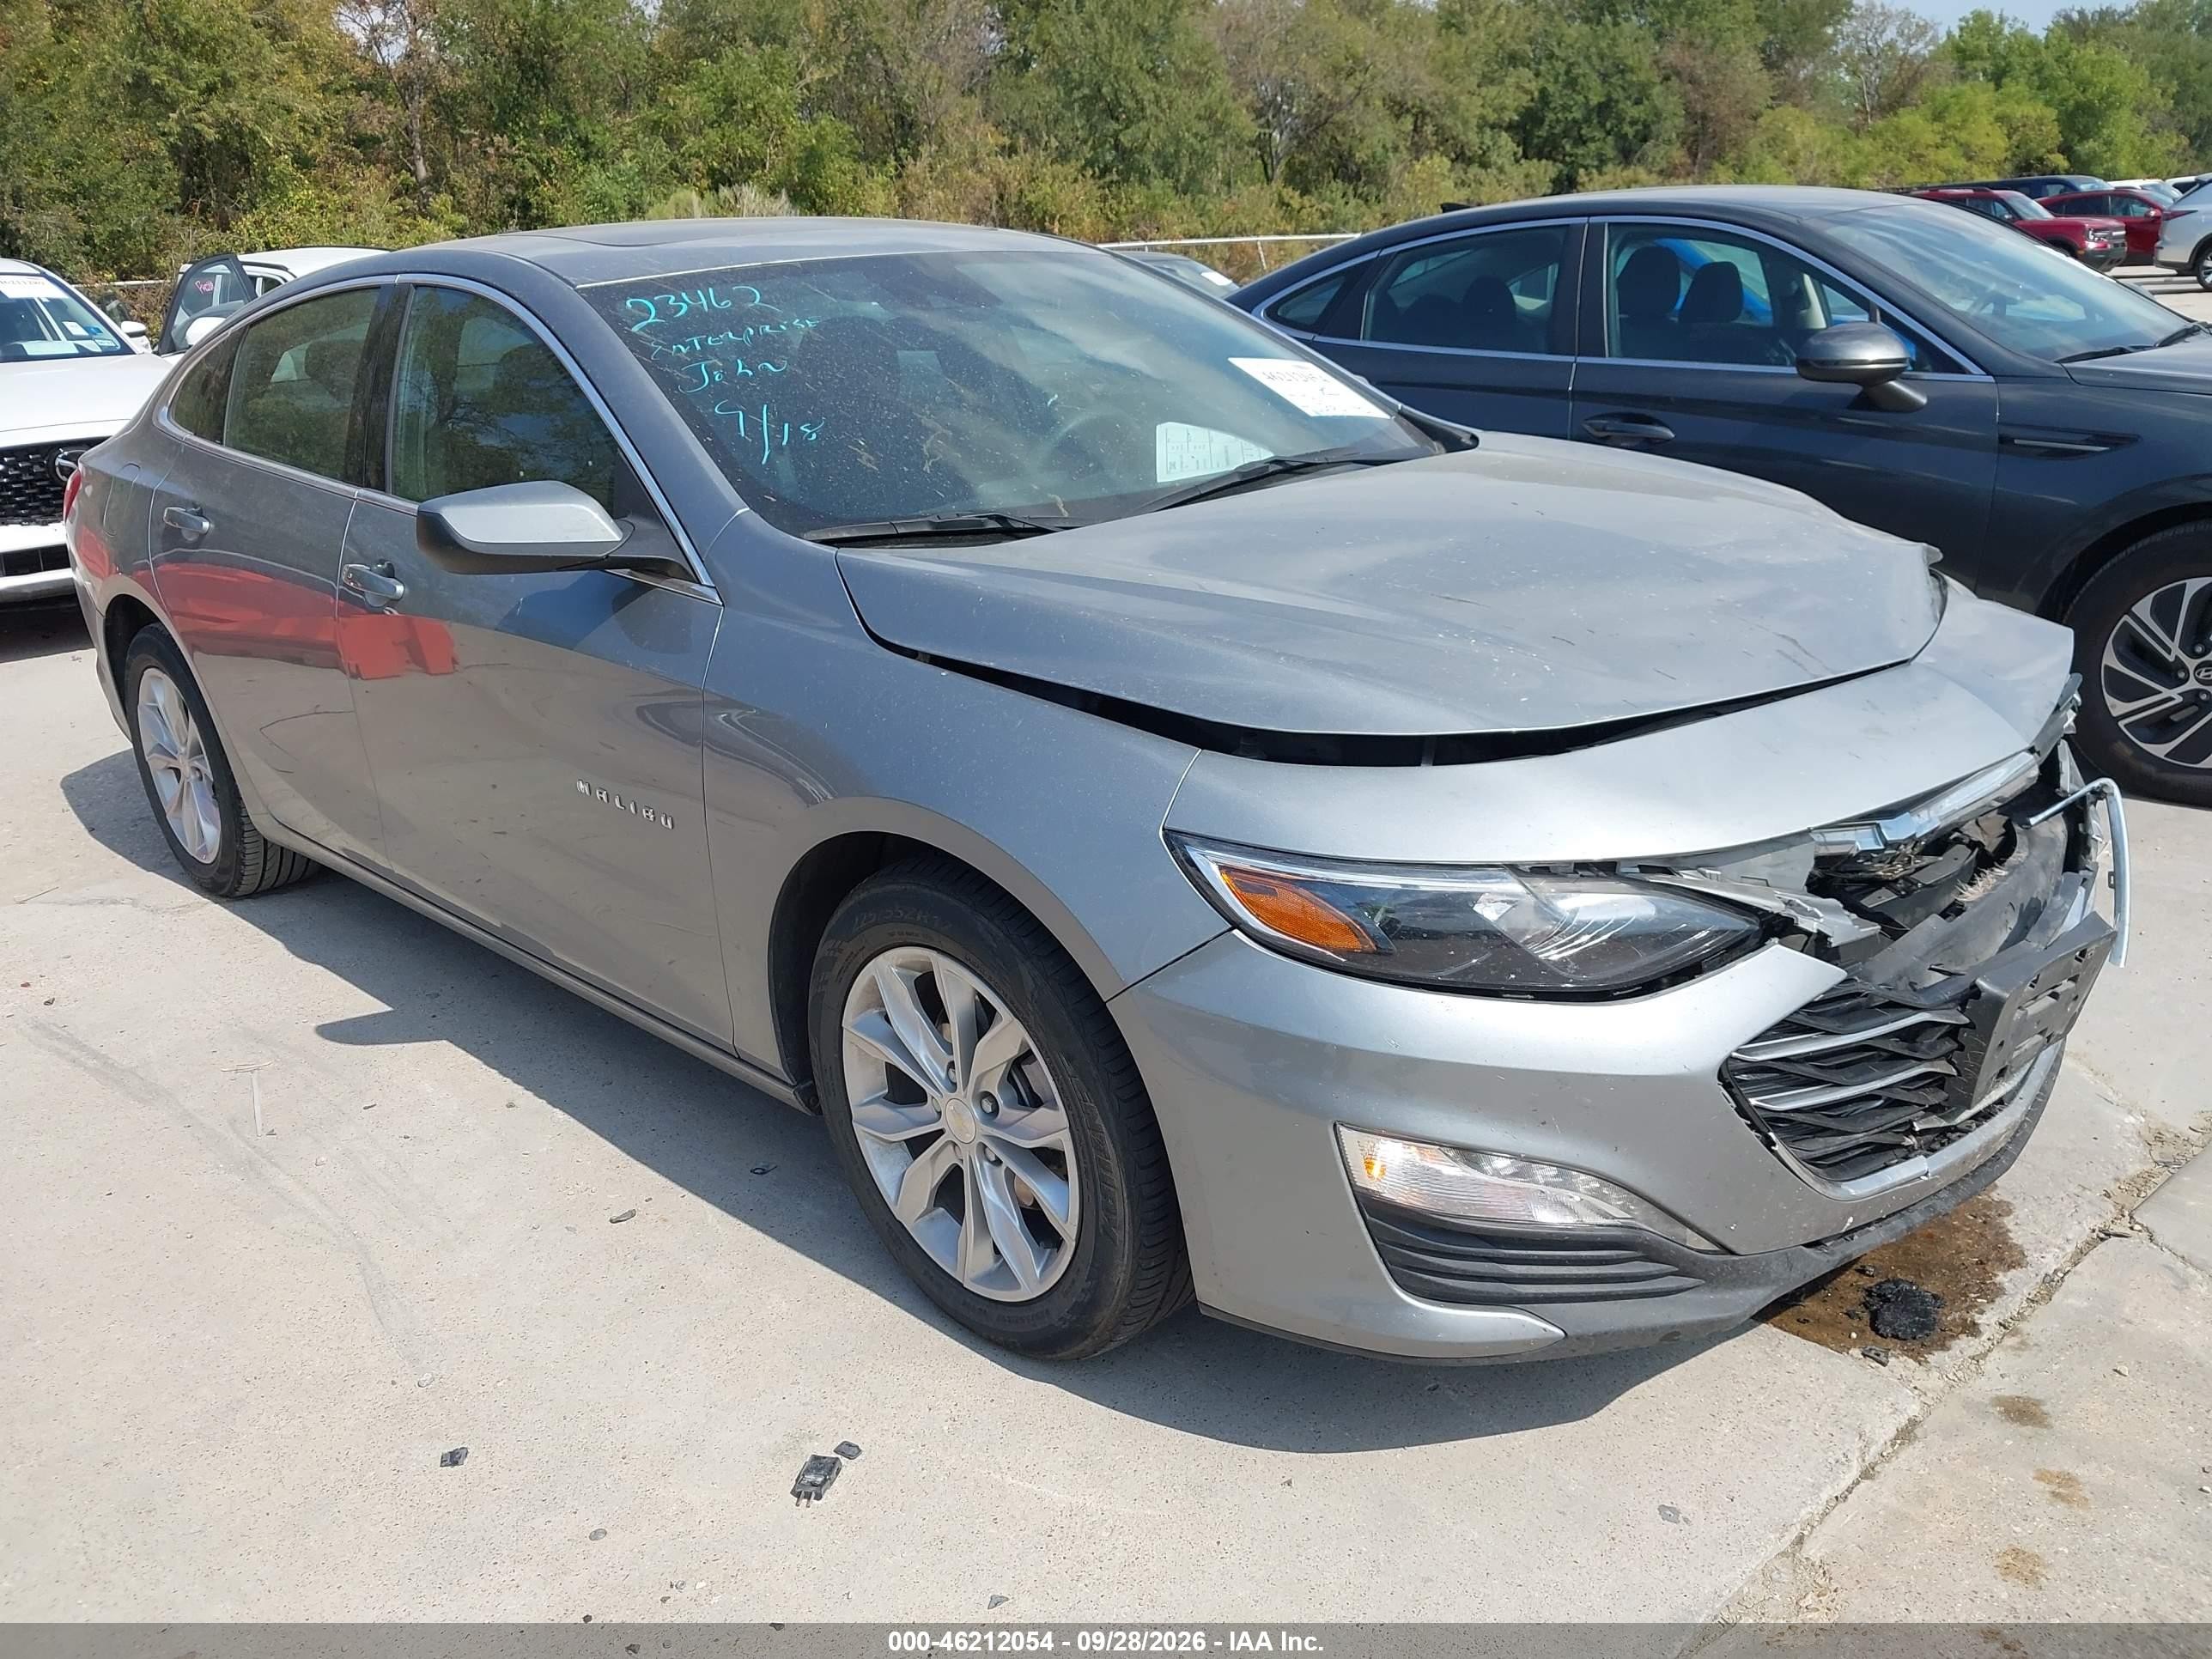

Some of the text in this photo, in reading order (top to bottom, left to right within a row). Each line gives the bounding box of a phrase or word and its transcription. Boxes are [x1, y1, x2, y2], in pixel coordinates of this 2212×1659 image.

[625, 285, 783, 332] 23462
[714, 398, 824, 465] 9/18
[576, 779, 674, 830] MALIBU
